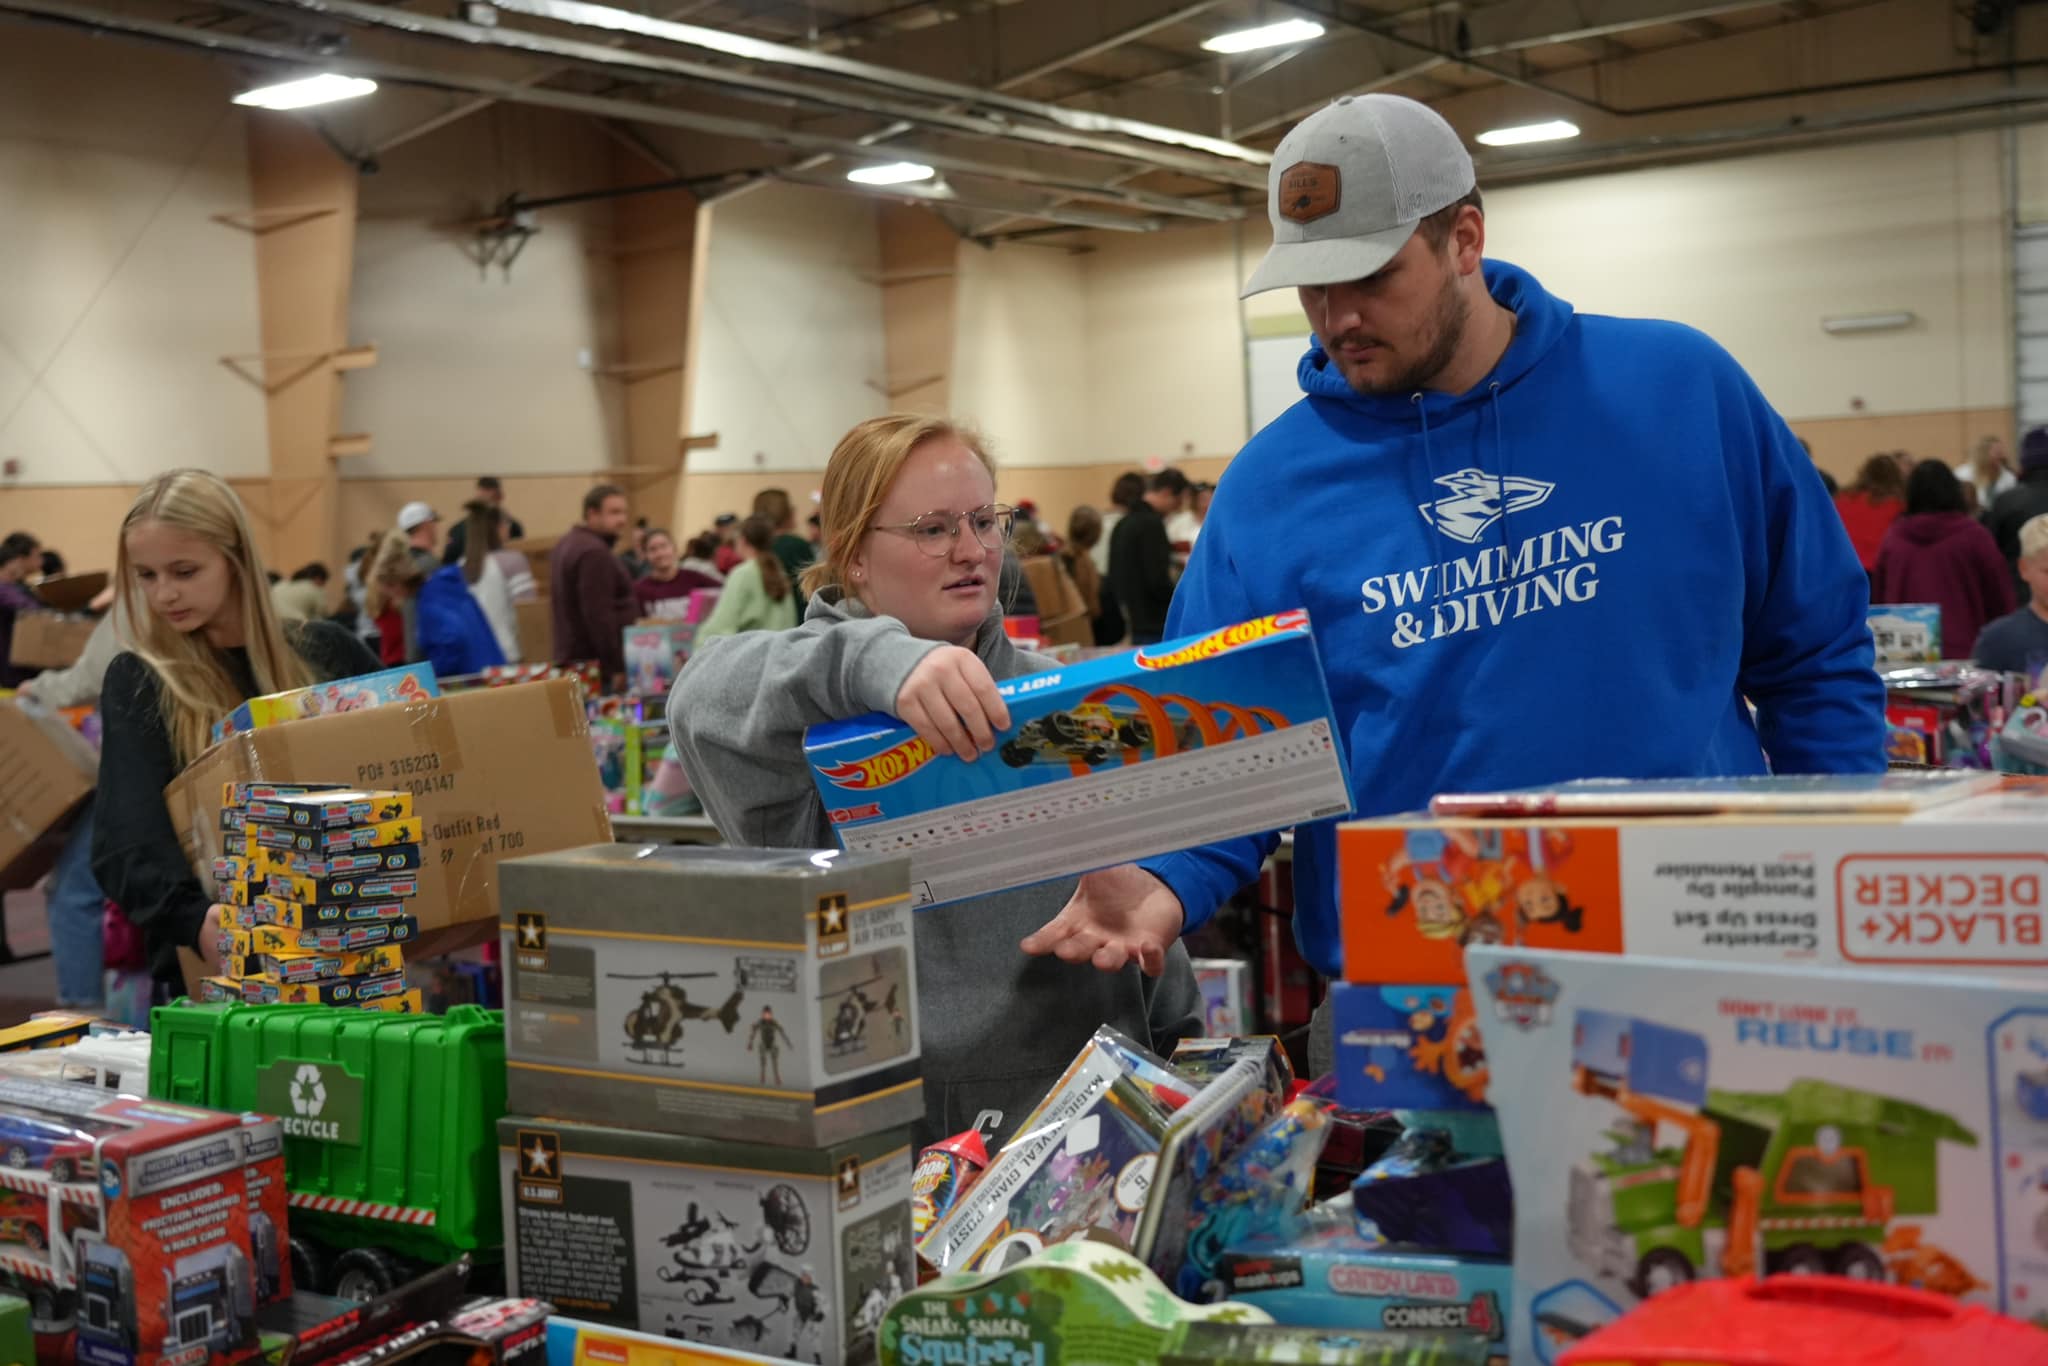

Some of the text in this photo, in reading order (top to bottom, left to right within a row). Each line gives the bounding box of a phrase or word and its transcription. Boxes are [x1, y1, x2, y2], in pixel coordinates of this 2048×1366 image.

[1362, 516, 1625, 613] SWIMMING
[1392, 562, 1599, 649] & DIVING
[1018, 674, 1061, 694] HOT
[390, 753, 440, 777] 315203
[862, 746, 908, 787] HOT
[477, 813, 501, 833] Red
[500, 831, 525, 850] 700
[1764, 863, 1815, 879] Petit
[1686, 882, 1816, 899] Panoplie Du
[1855, 874, 2040, 907] DECKER
[1673, 909, 1817, 929] Dress Up Set
[1860, 913, 2042, 945] BLACK+
[1703, 930, 1818, 949] Carpenter
[1737, 1018, 1914, 1060] REUSE
[1063, 1073, 1104, 1118] MAGIC
[284, 1117, 339, 1139] ECYCLE
[1330, 1265, 1460, 1298] CANDY LAND
[922, 1301, 948, 1316] THE
[1384, 1295, 1494, 1335] CONNECT 4
[967, 1316, 1031, 1339] SNACKY
[900, 1333, 1046, 1366] Squirrel
